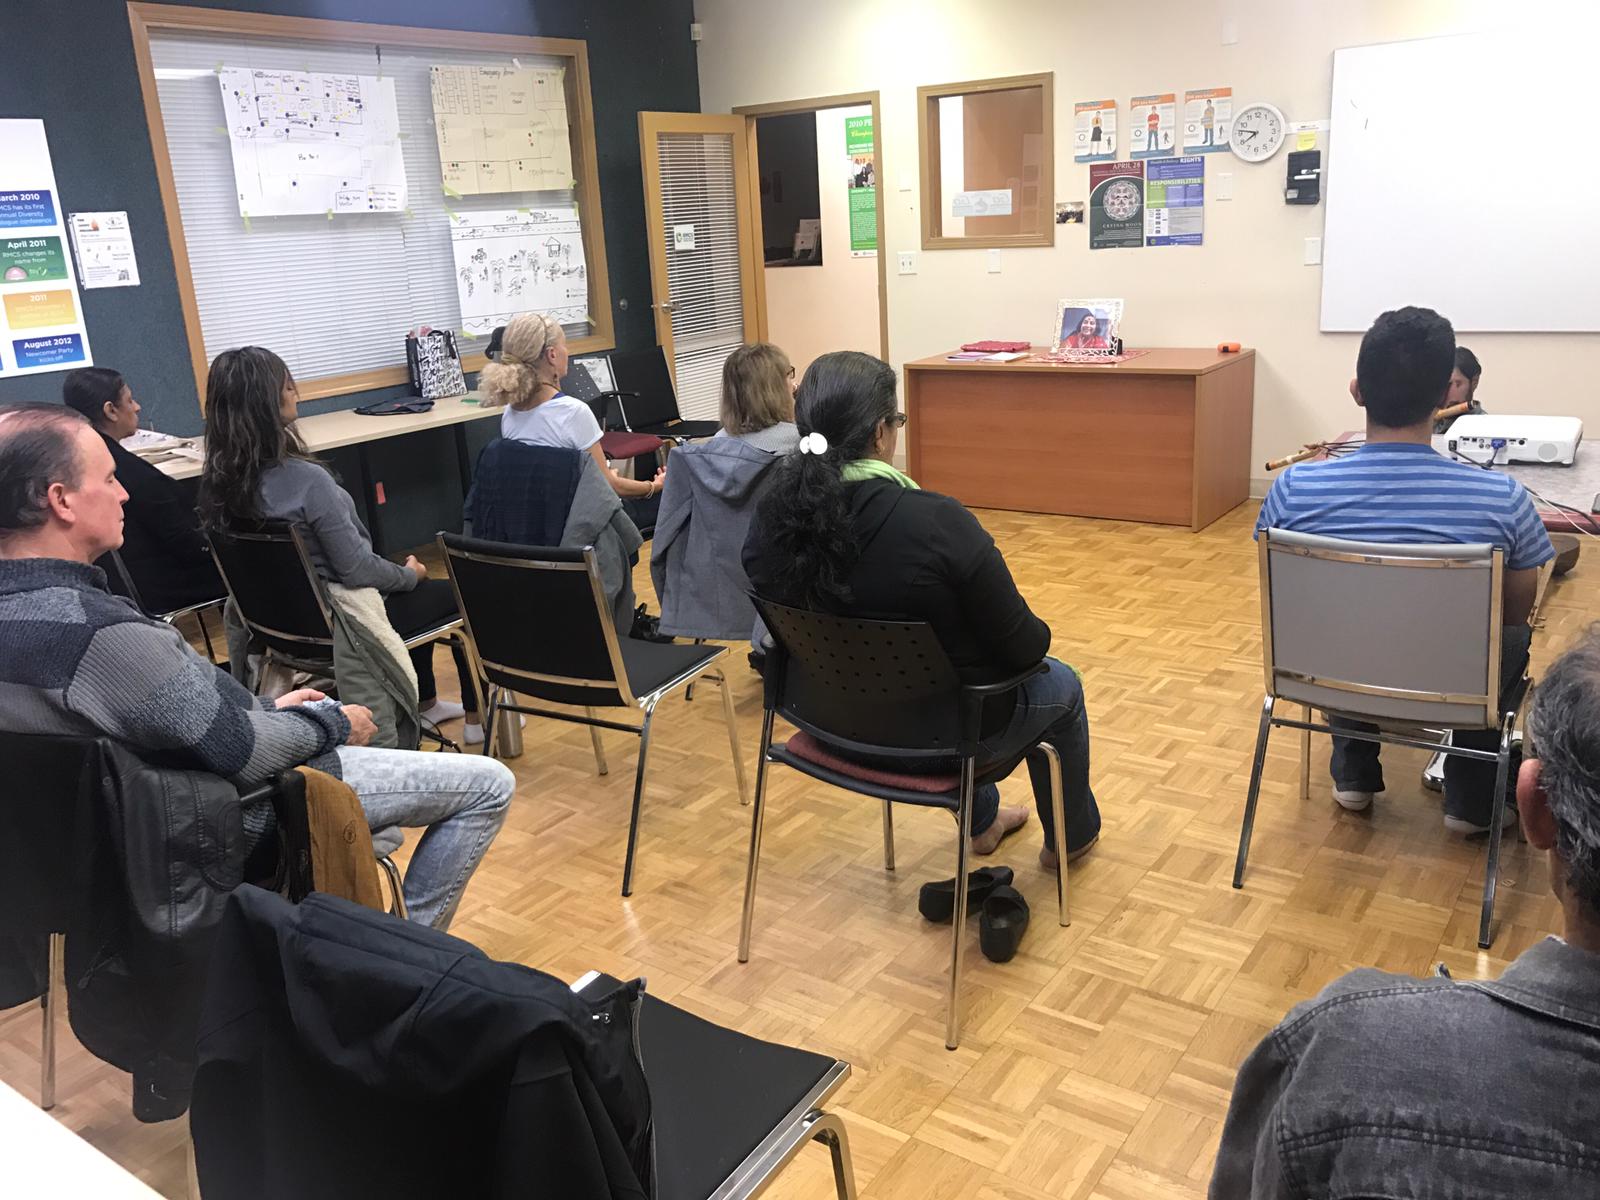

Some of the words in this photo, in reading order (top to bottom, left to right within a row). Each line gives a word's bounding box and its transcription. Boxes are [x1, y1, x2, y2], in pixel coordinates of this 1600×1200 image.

[1180, 156, 1202, 164] RIGHTS
[1112, 162, 1131, 170] APRIL
[0, 193, 19, 202] arch
[20, 193, 40, 201] 2010
[7, 240, 28, 250] April
[29, 239, 47, 248] 2011
[30, 294, 47, 302] 2011
[24, 340, 52, 350] August
[53, 337, 73, 346] 2012
